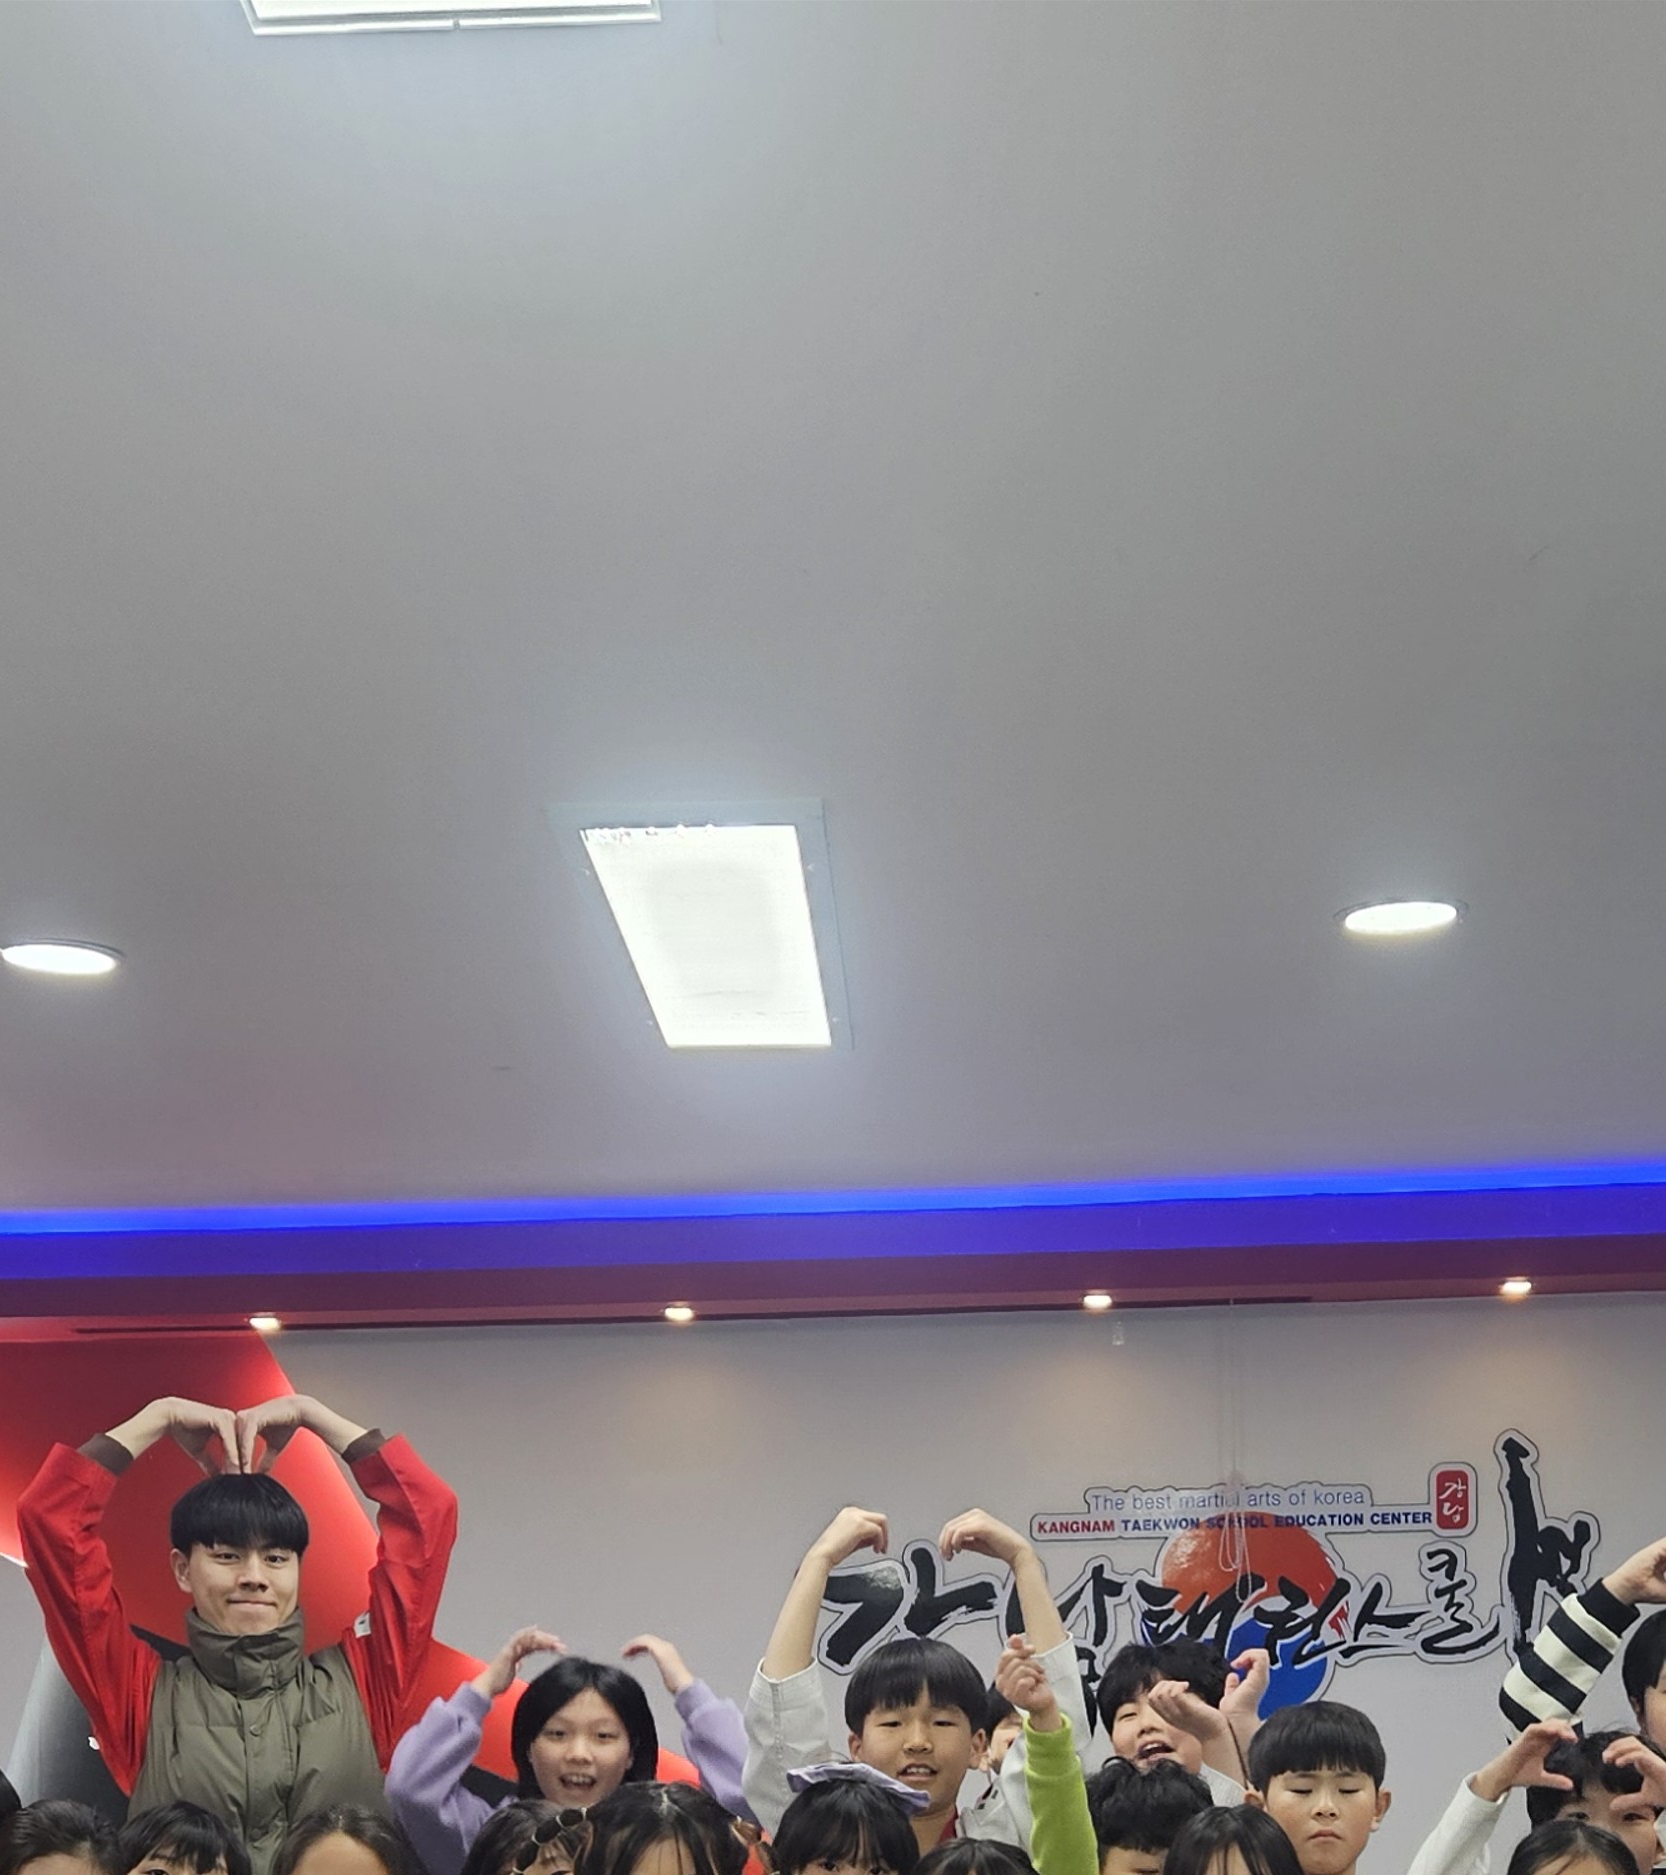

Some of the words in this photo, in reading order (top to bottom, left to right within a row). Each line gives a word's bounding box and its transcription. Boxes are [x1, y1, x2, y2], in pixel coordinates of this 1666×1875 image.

[1091, 1494, 1126, 1511] The
[1133, 1493, 1171, 1510] best
[1247, 1490, 1282, 1507] arts
[1289, 1488, 1306, 1506] of
[1313, 1488, 1365, 1505] korea
[1037, 1519, 1115, 1534] KANGNAM
[1121, 1517, 1200, 1532] TAEKWON
[1275, 1512, 1364, 1527] EDUCATION
[1370, 1510, 1432, 1525] CENTER
